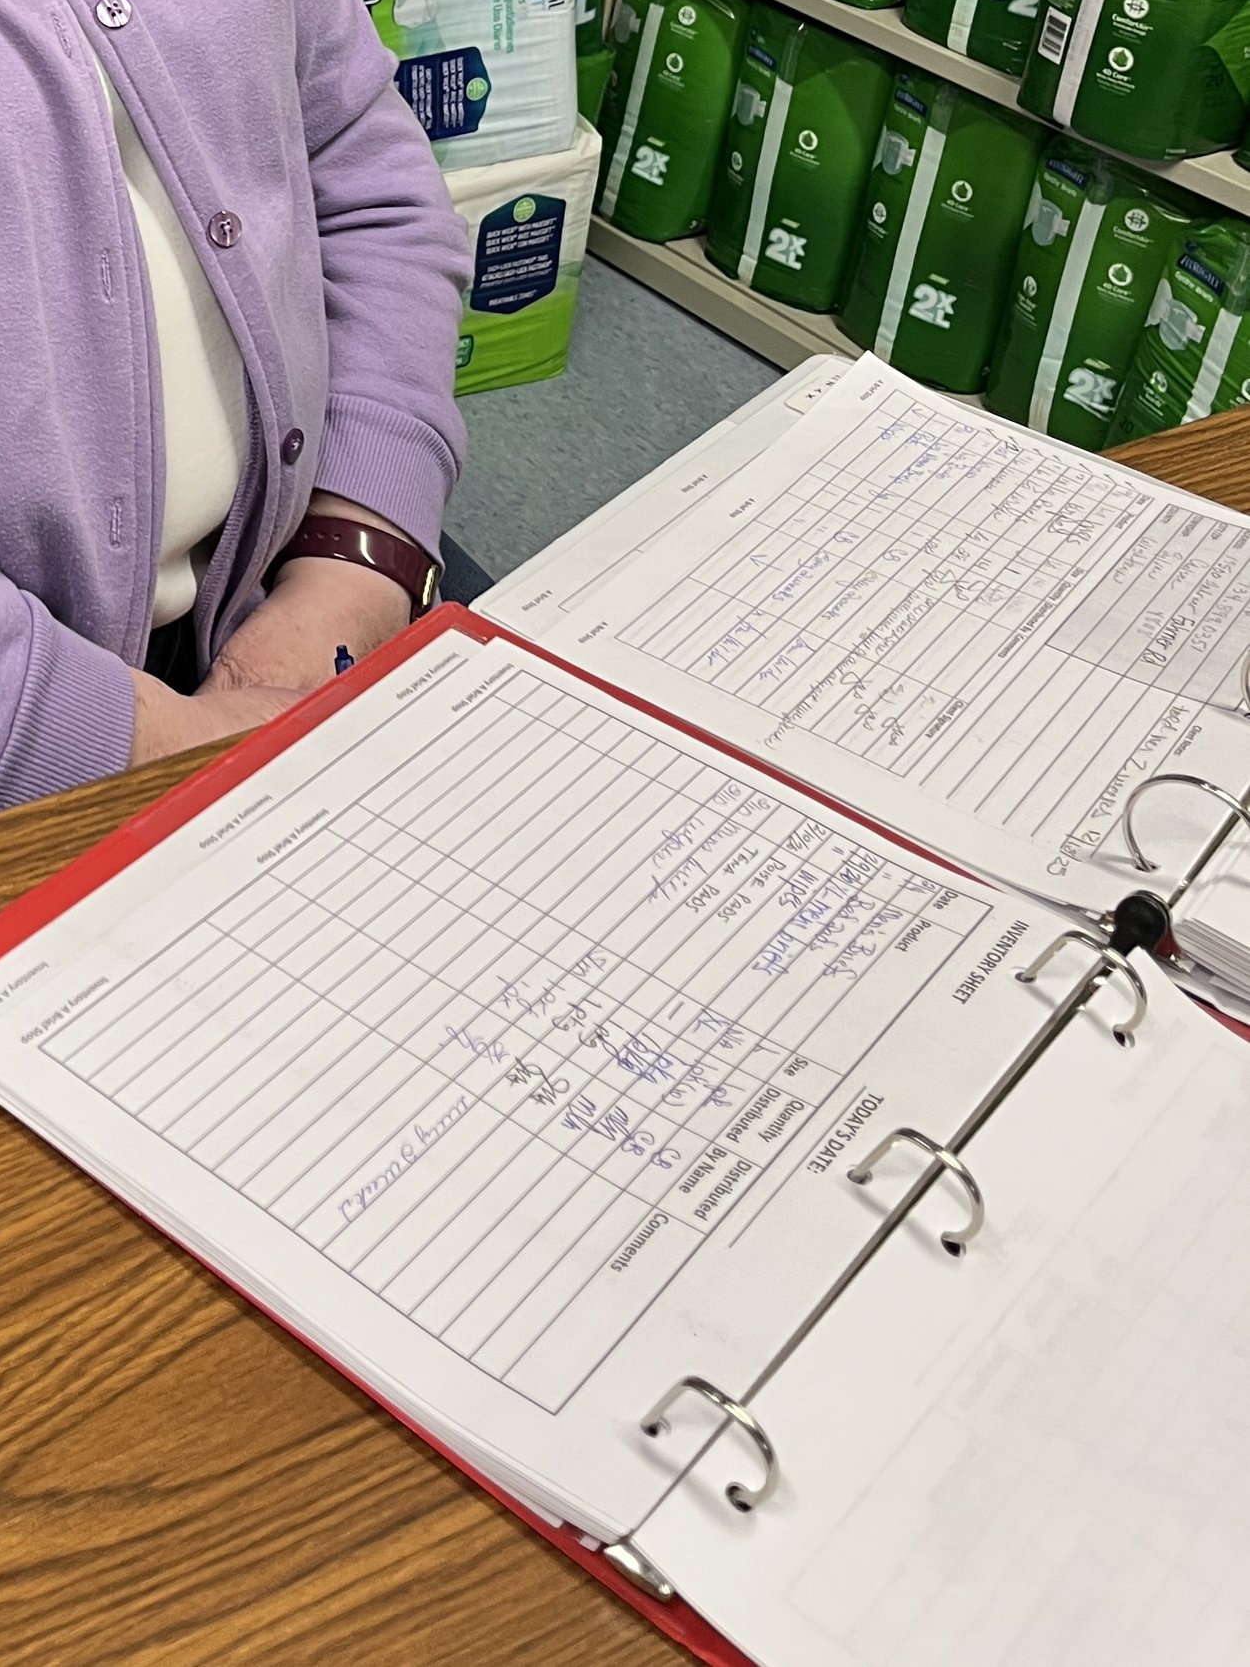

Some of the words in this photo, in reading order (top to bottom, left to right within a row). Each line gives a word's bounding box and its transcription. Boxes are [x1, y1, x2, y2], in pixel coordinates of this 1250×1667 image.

[932, 886, 958, 909] Date
[894, 915, 931, 952] Product
[977, 920, 1028, 974] INVENTORY
[952, 971, 985, 1004] SHEET
[783, 1053, 808, 1076] Size
[726, 1082, 780, 1142] Distributed
[758, 1093, 804, 1142] Quantity
[835, 1093, 883, 1141] TODAY'S
[704, 1141, 727, 1162] By
[806, 1138, 844, 1173] DATE:
[678, 1161, 714, 1193] Name
[694, 1159, 751, 1220] Distributed
[610, 1207, 668, 1271] Comments
